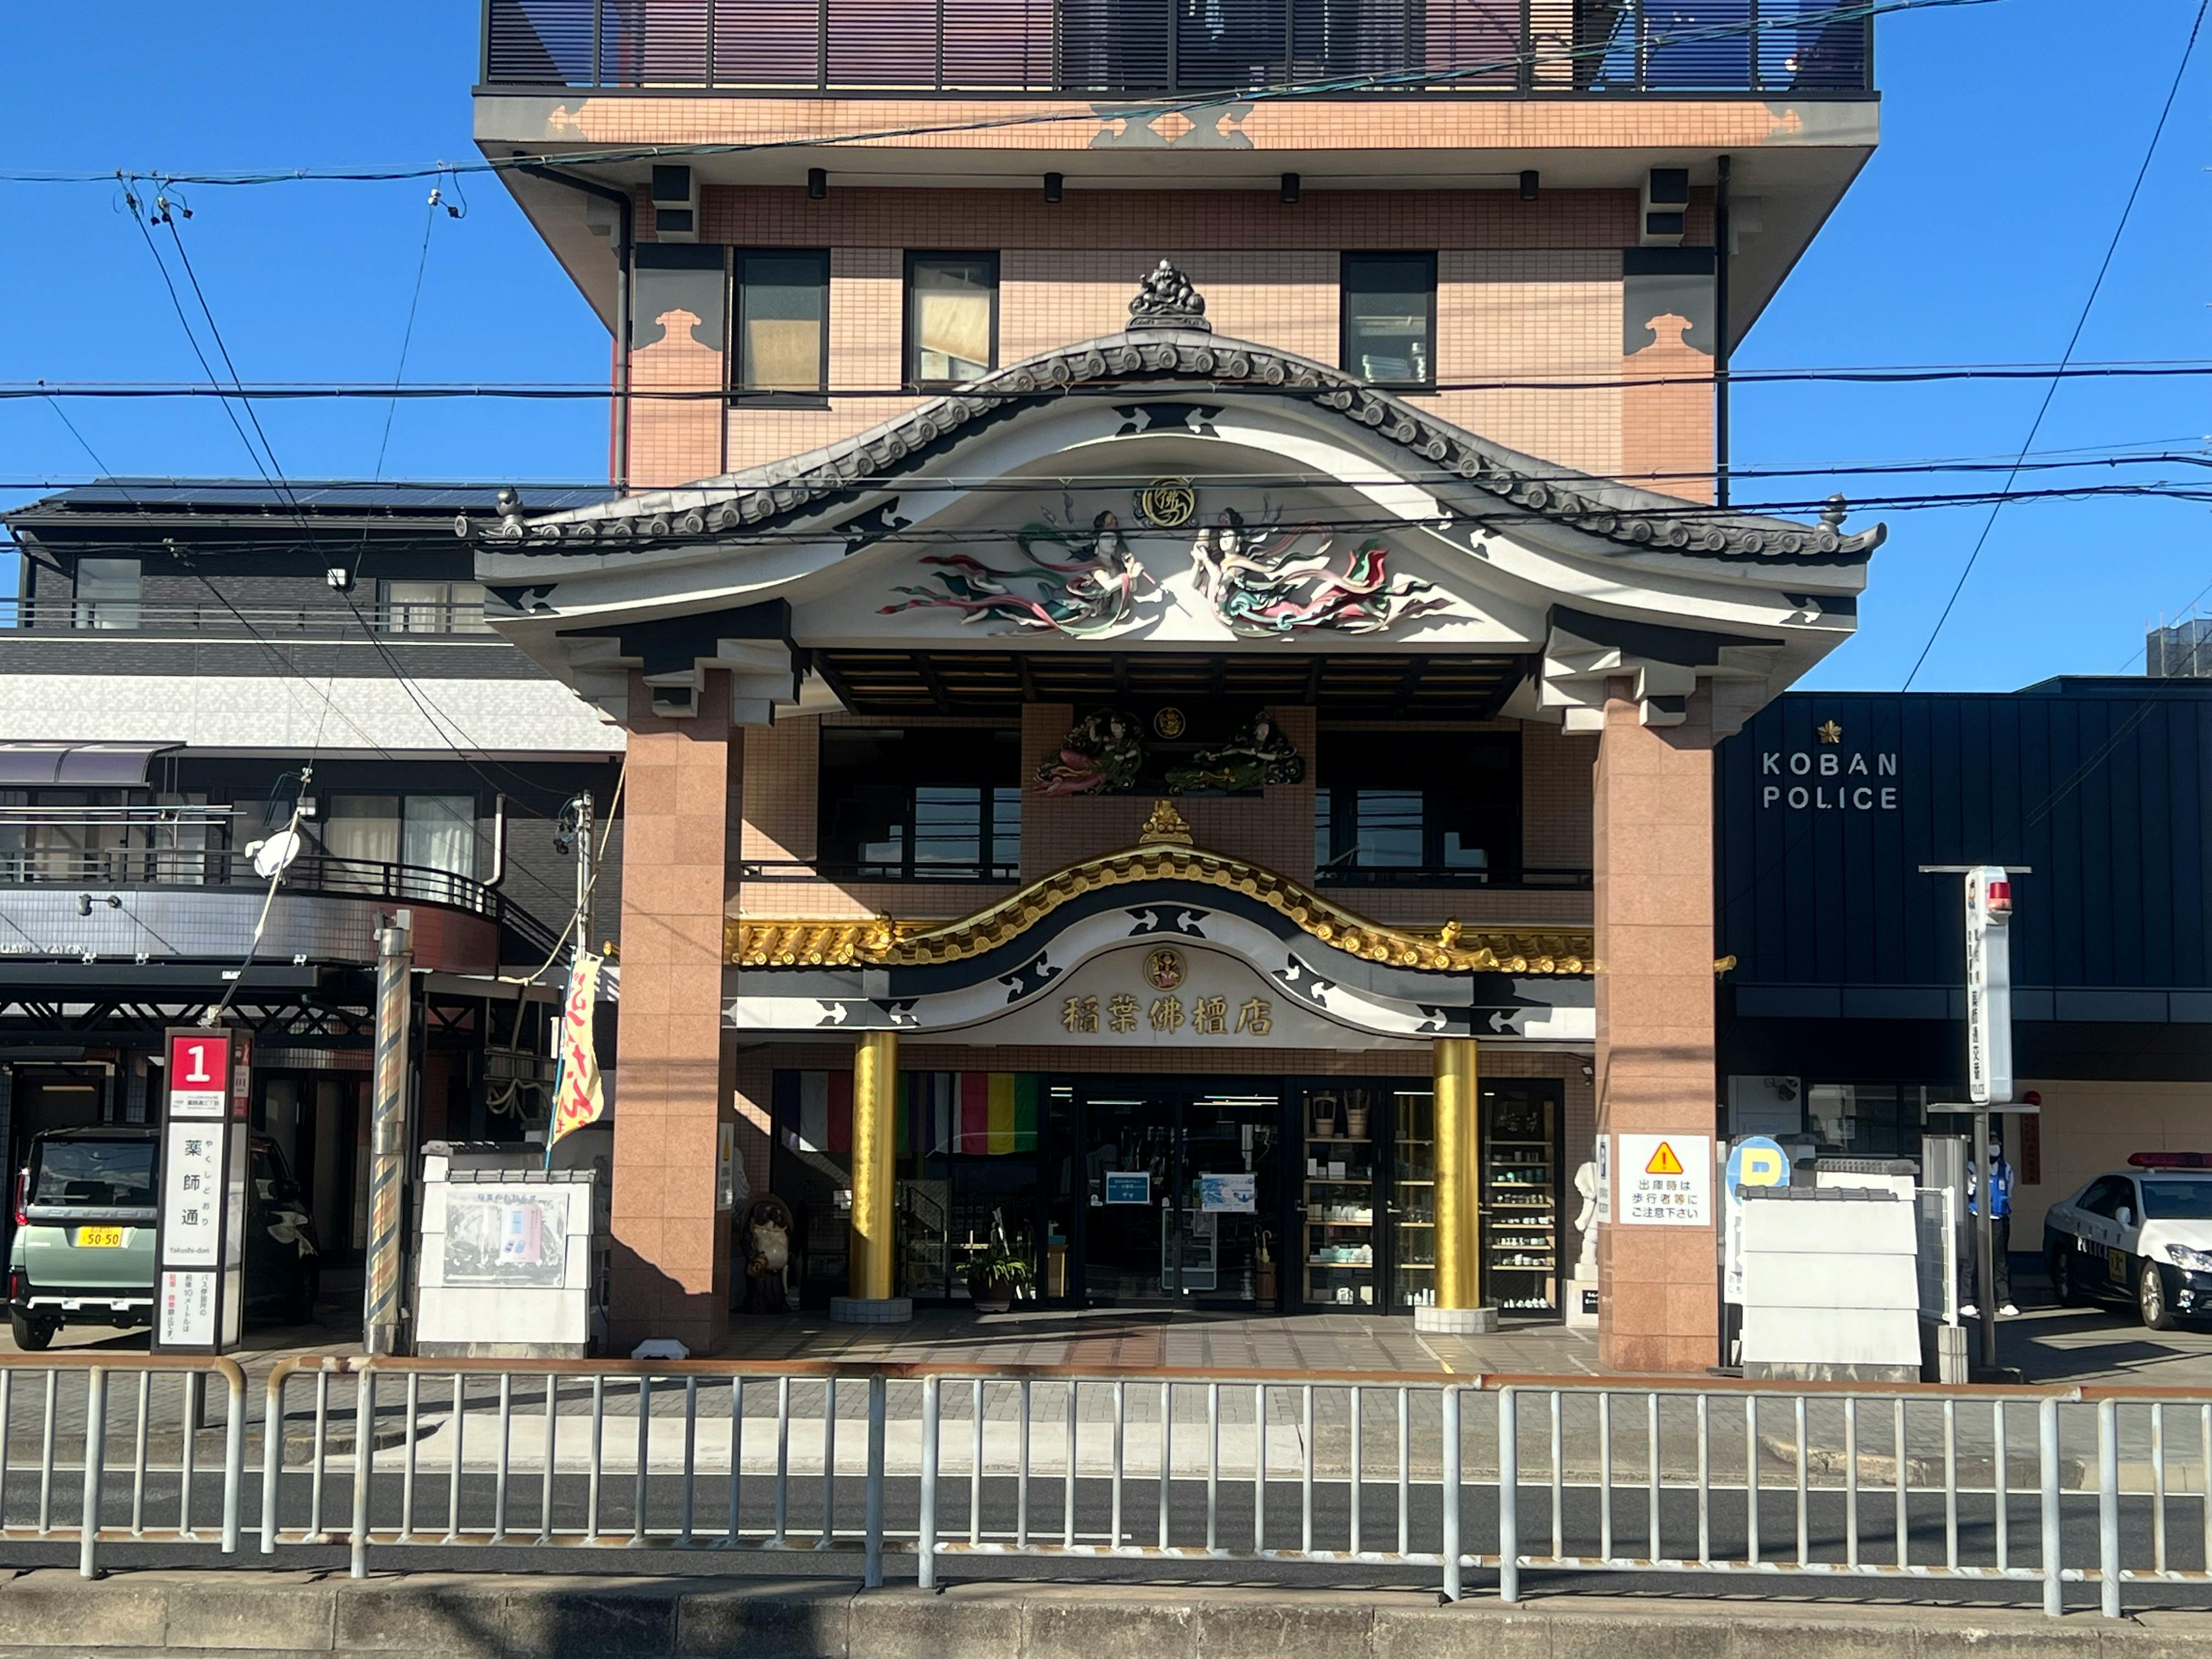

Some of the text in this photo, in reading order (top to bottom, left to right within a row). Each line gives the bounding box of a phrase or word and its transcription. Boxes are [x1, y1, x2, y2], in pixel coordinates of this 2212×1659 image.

[1763, 752, 1897, 776] KOBAN
[1763, 786, 1897, 810] POLICE
[185, 1045, 211, 1082] 1
[1740, 1148, 1782, 1186] P
[181, 1139, 202, 1226] 薬師通
[202, 1141, 213, 1226] やくしどおり
[1638, 1179, 1691, 1190] 出庫時は
[1632, 1193, 1698, 1205] 歩行者等に
[1632, 1207, 1699, 1218] ご注意下さい
[2077, 1236, 2108, 1260] POLICE
